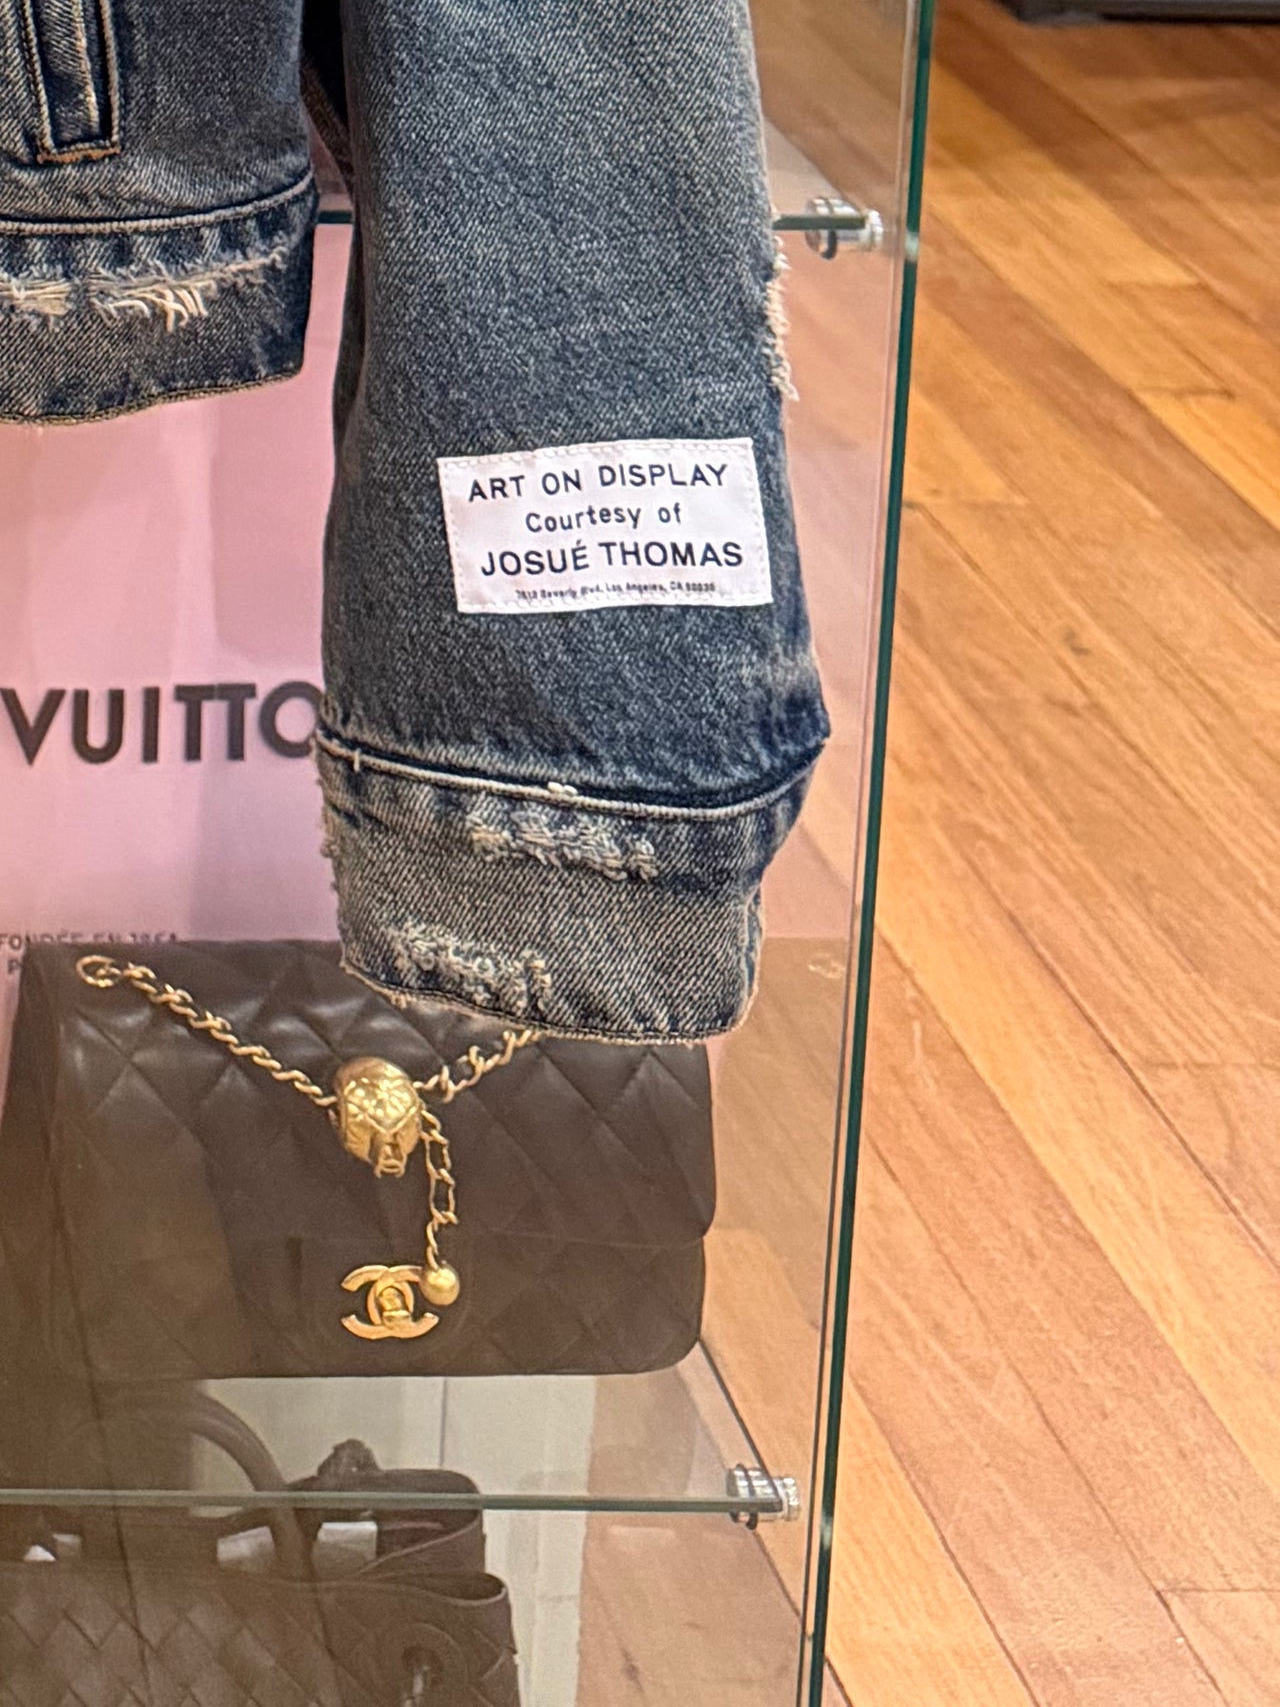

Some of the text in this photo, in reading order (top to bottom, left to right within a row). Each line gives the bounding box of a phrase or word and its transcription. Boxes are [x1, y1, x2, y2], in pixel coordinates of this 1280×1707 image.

[468, 463, 728, 502] ART ON DISPLAY
[525, 502, 682, 533] Courtesy of
[481, 540, 743, 577] JOSUÉ THOMAS
